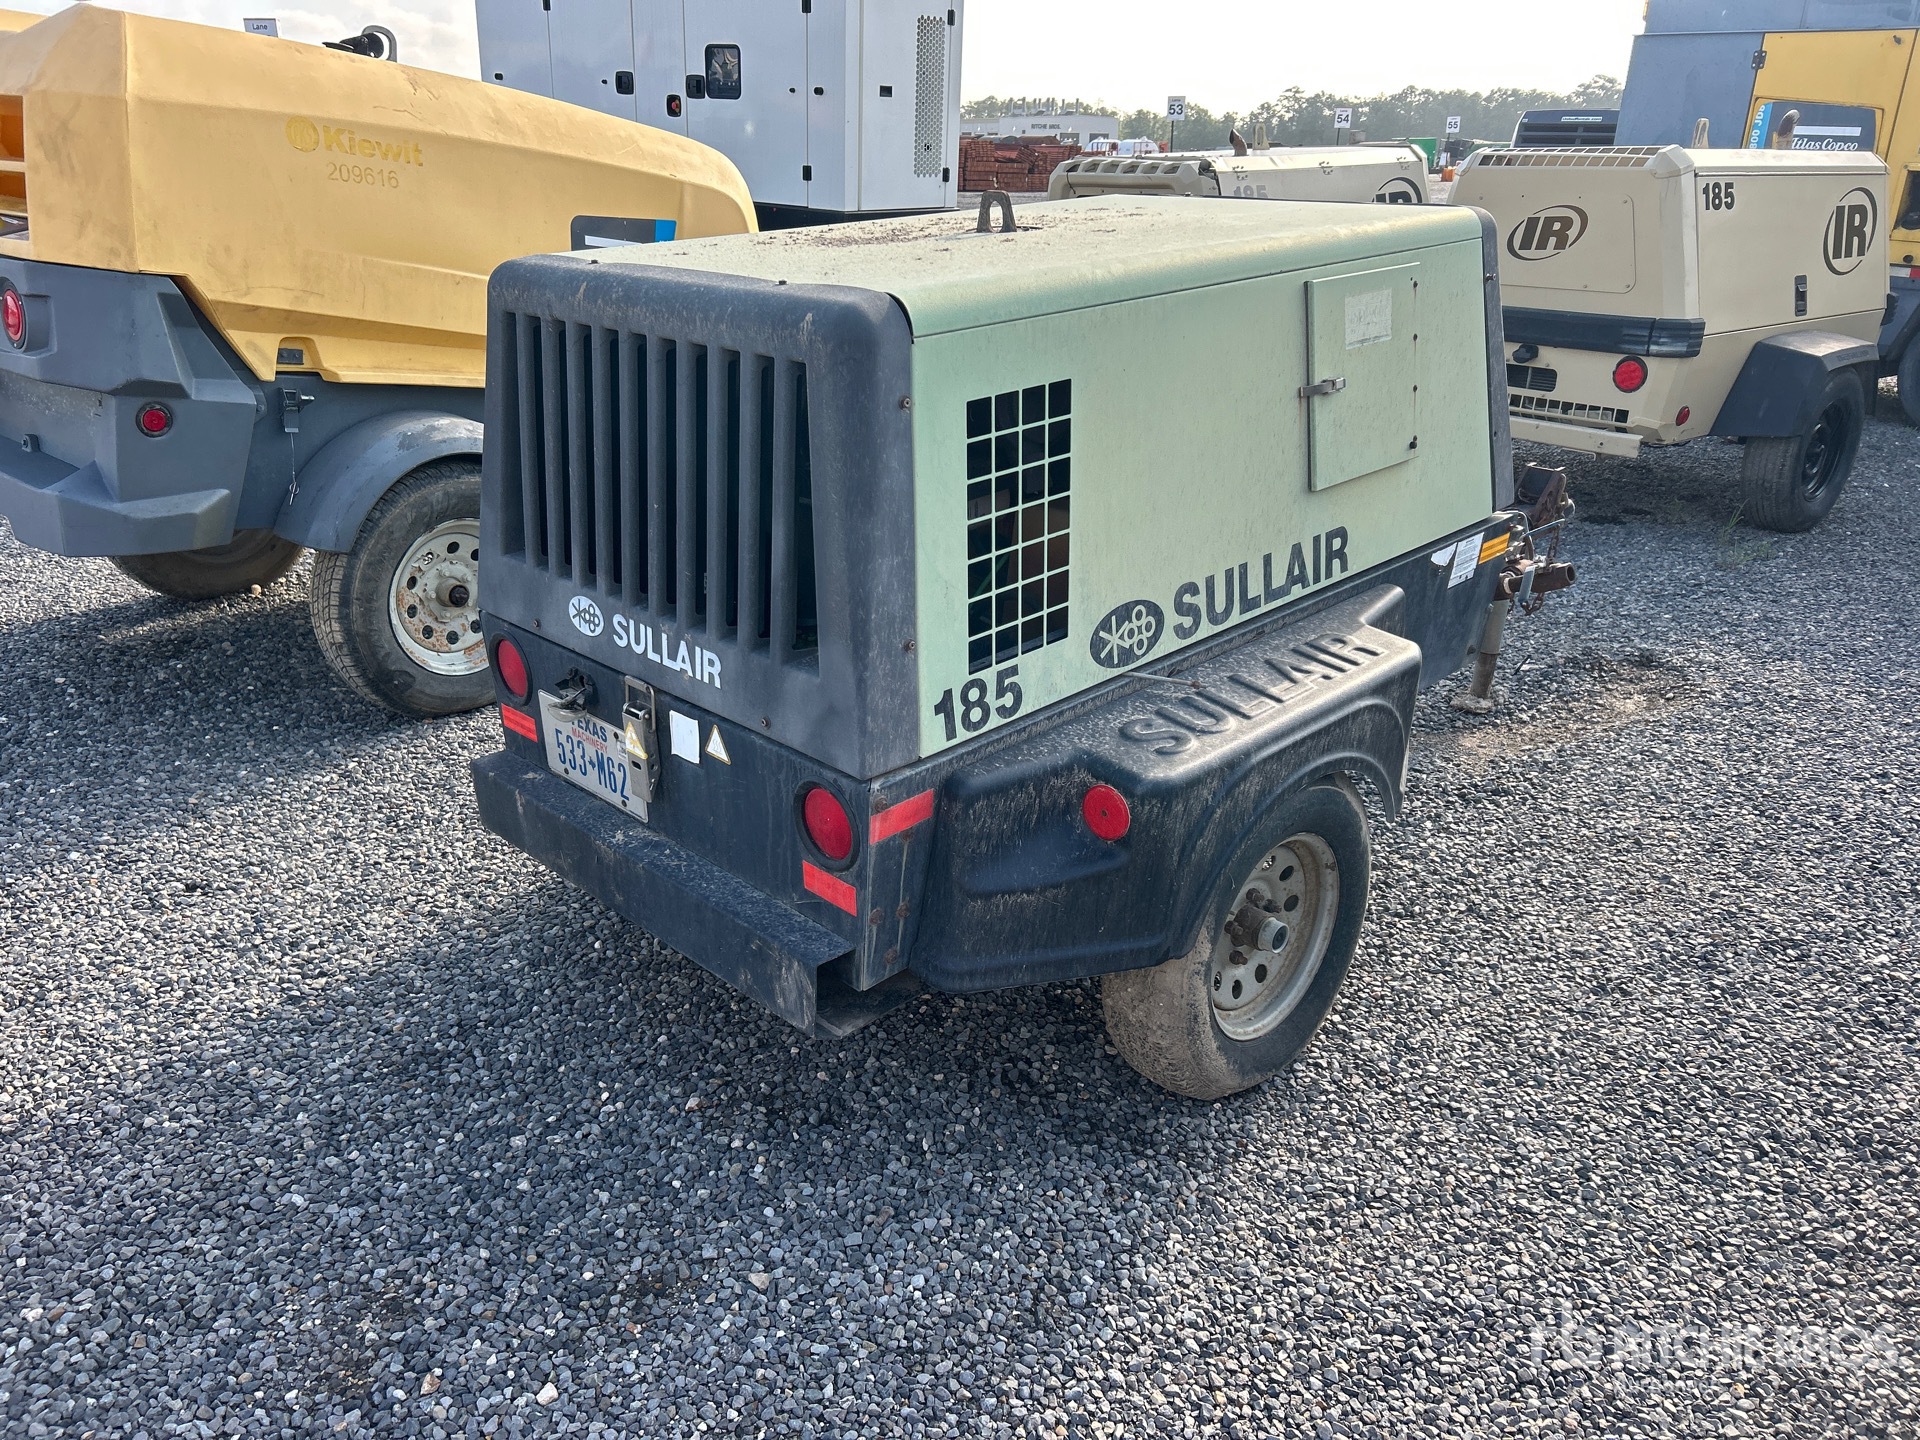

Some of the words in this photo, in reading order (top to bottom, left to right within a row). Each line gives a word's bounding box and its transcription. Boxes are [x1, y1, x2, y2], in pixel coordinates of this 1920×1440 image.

[1168, 104, 1184, 115] 53
[1336, 114, 1350, 124] 54
[1448, 121, 1459, 129] 55
[322, 125, 424, 167] Kiewit
[1821, 138, 1859, 151] Copco
[326, 161, 400, 189] 209616
[1702, 181, 1736, 211] 185
[1517, 215, 1574, 251] IR
[1831, 204, 1869, 260] IR
[1172, 525, 1349, 641] SULLAIR
[612, 613, 722, 690] SULLAIR
[933, 663, 1023, 742] 185
[1117, 632, 1387, 756] SULLAIR
[571, 717, 608, 743] EXAS
[571, 727, 608, 754] MACHINERY
